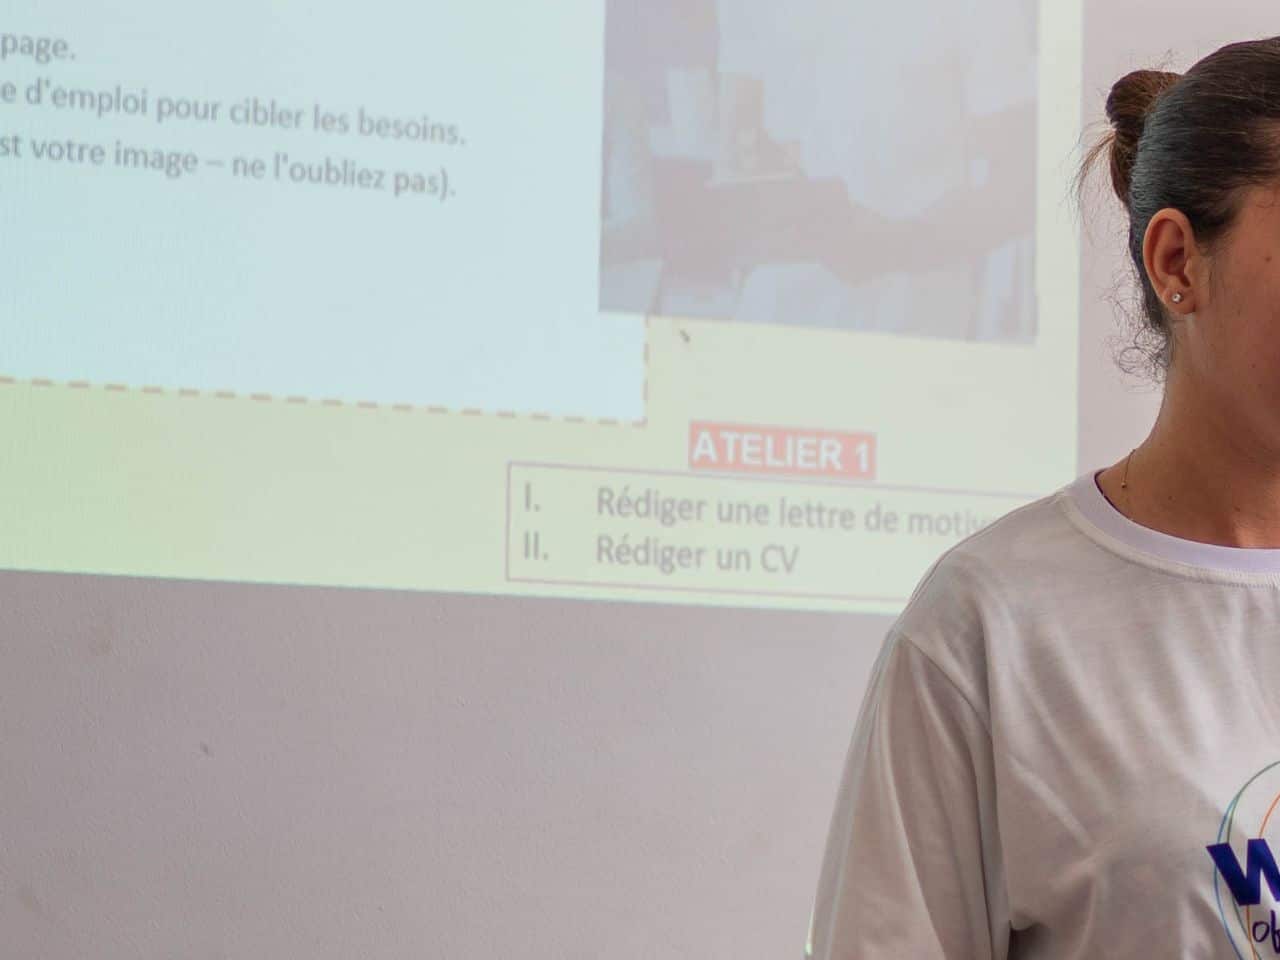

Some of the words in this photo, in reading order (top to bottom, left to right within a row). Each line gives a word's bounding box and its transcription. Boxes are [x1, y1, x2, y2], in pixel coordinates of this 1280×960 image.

[0, 31, 76, 64] page.
[25, 76, 148, 119] d'emploi
[156, 96, 220, 124] pour
[229, 97, 304, 129] cibler
[313, 102, 350, 133] les
[358, 104, 467, 146] besoins.
[31, 136, 106, 165] votre
[114, 139, 198, 178] image
[232, 155, 266, 179] ne
[273, 151, 386, 191] l'oubliez
[393, 165, 457, 204] pas).
[691, 429, 843, 472] ATELIER
[855, 439, 870, 473] 1
[596, 484, 707, 527] Rédiger
[716, 499, 771, 526] une
[779, 496, 857, 531] lettre
[863, 501, 900, 533] de
[596, 532, 706, 576] Rédiger
[716, 547, 752, 572] un
[759, 543, 800, 574] CV
